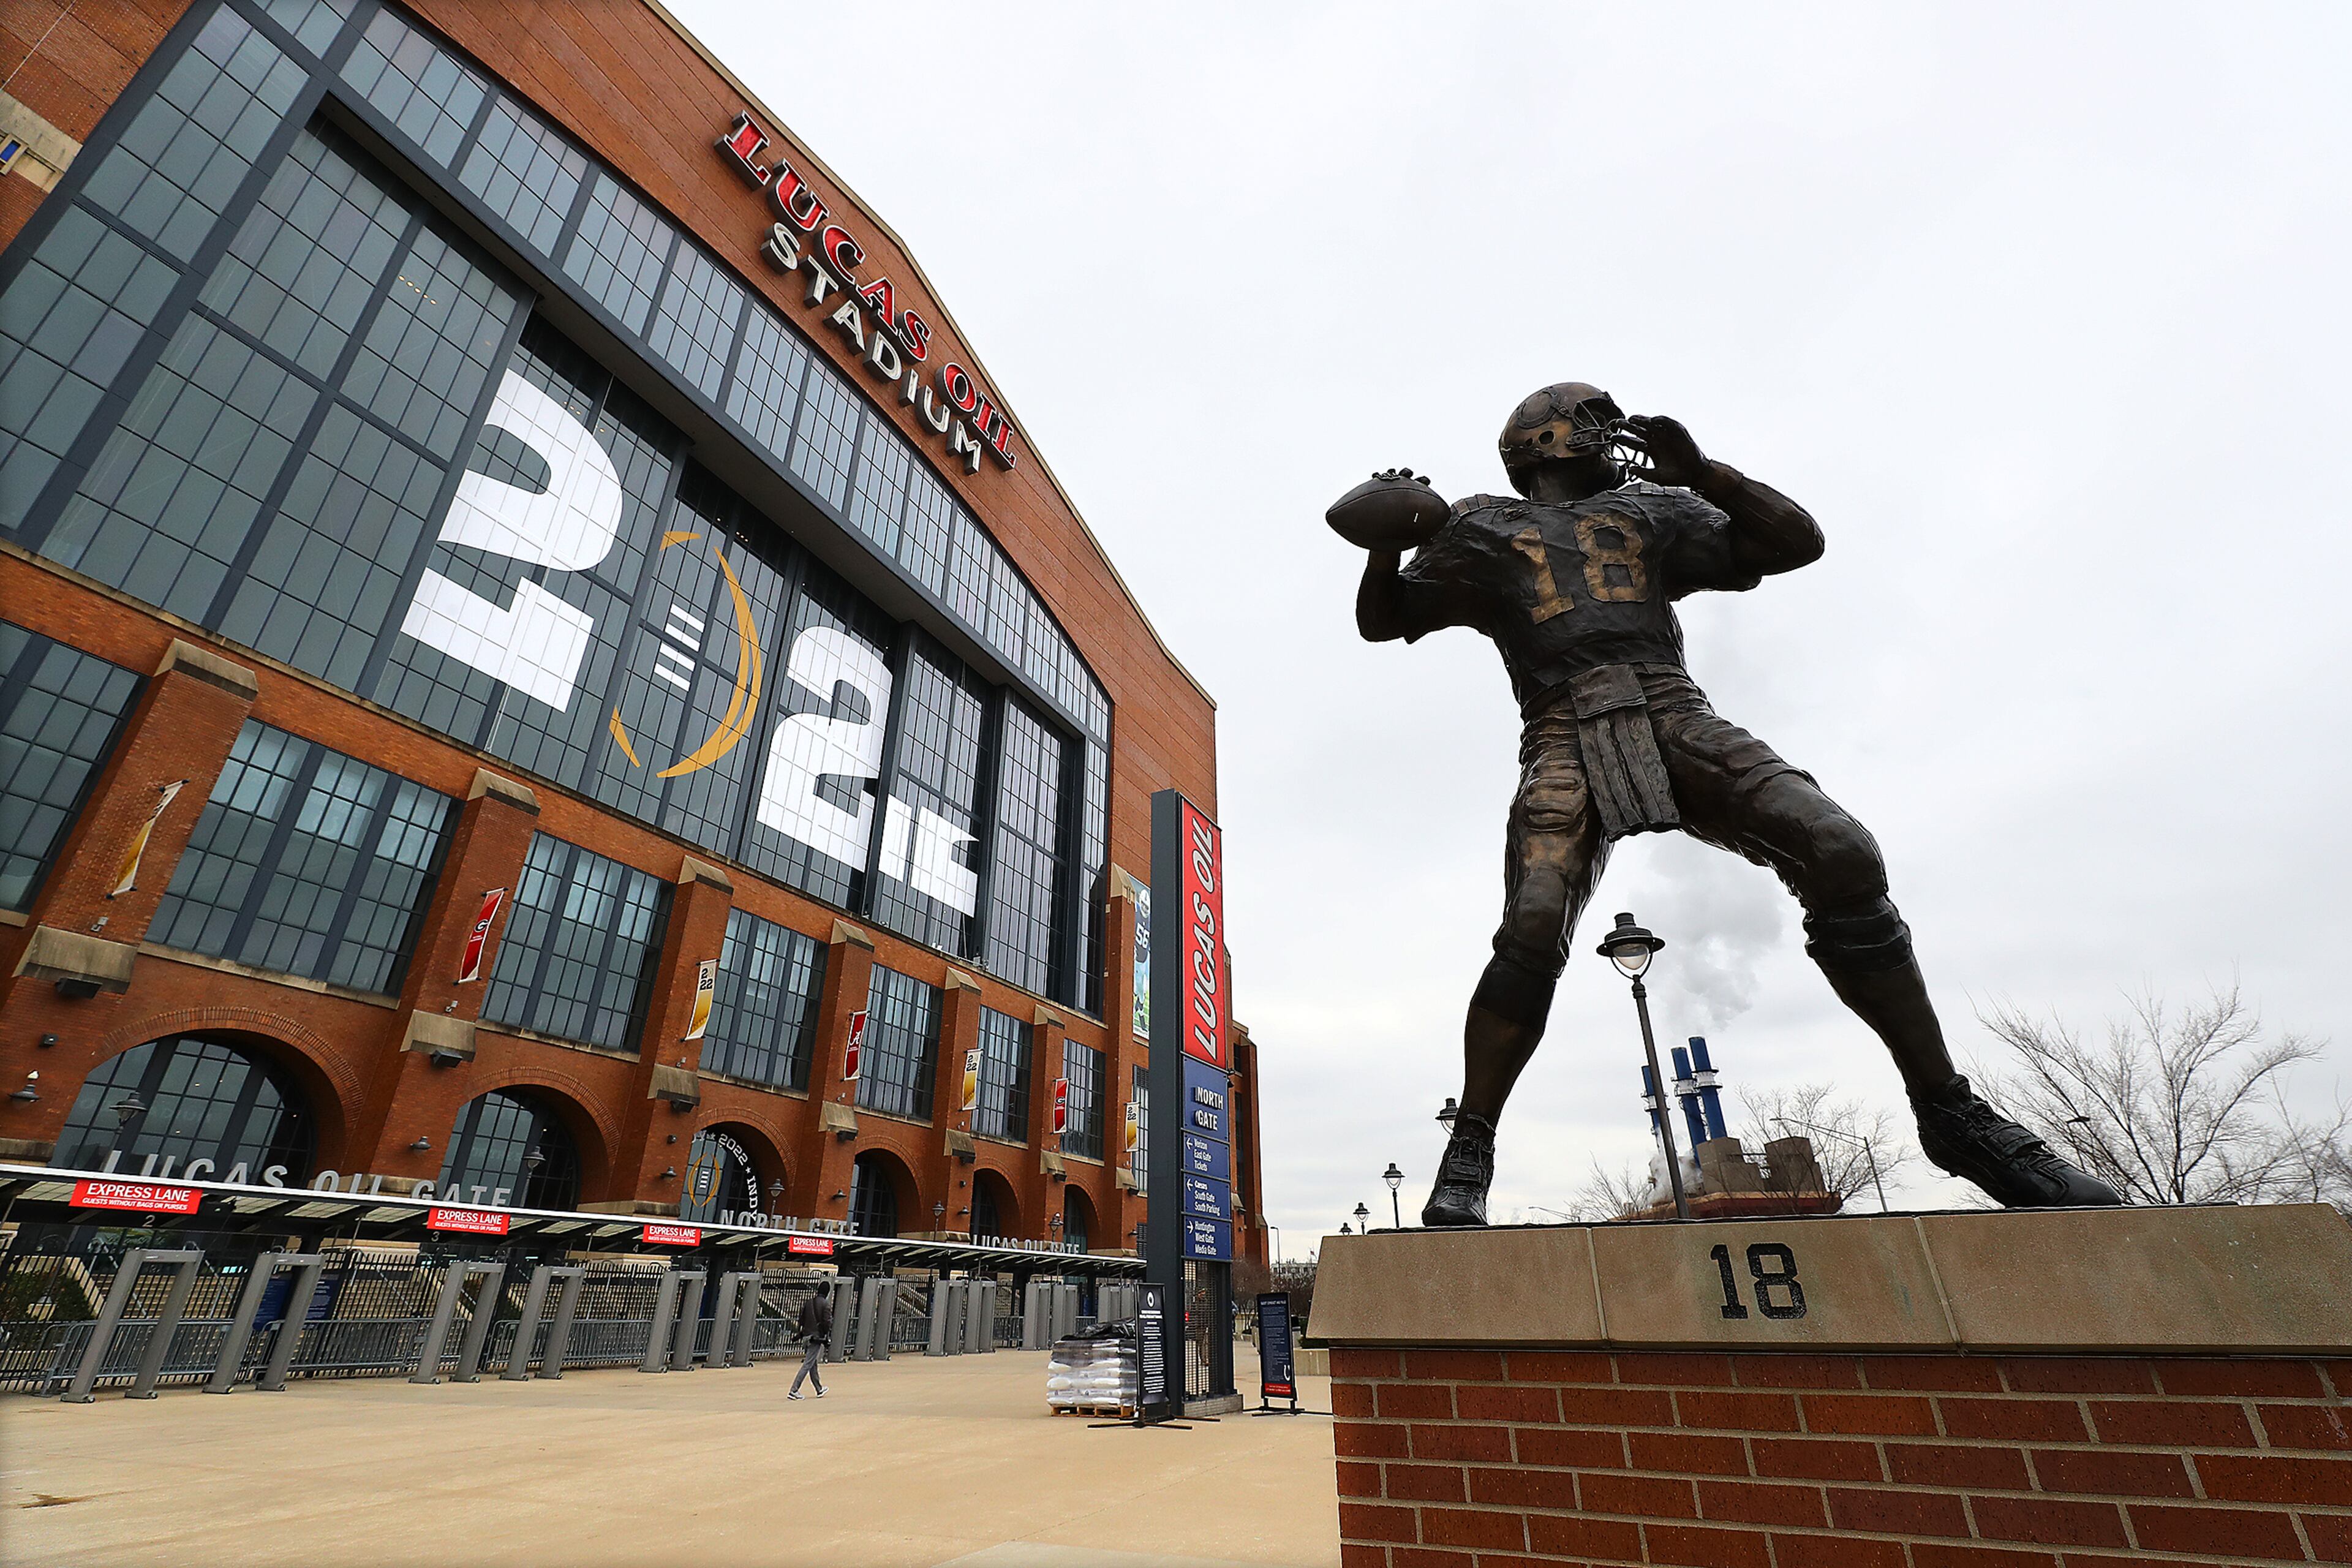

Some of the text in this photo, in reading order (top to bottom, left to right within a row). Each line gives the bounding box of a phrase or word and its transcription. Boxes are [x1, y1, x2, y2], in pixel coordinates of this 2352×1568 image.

[714, 110, 1017, 471] LUCAS OIL
[761, 222, 981, 475] STADIUM
[1510, 513, 1649, 625] 18
[1136, 922, 1150, 949] 56
[1192, 816, 1217, 1060] LUCAS OIL
[1196, 1086, 1224, 1110] NORTH
[1196, 1110, 1218, 1131] GATE
[718, 1134, 748, 1166] 2022
[1202, 1152, 1212, 1162] Gate
[1194, 1159, 1208, 1171] Tickets
[87, 1183, 191, 1202] EXPRESS LANE
[747, 1175, 758, 1221] INDY
[1194, 1190, 1215, 1202] South Gate
[1194, 1201, 1221, 1216] South Parking
[142, 1215, 155, 1227] 2
[437, 1210, 503, 1224] EXPRESS LANE
[431, 1231, 440, 1242] 3
[649, 1226, 696, 1237] EXPRESS LANE
[1195, 1232, 1215, 1243] West Gate
[633, 1244, 639, 1253] 4
[793, 1237, 815, 1246] EXPRESS
[1195, 1244, 1216, 1255] Media Gate
[1711, 1243, 1807, 1318] 18
